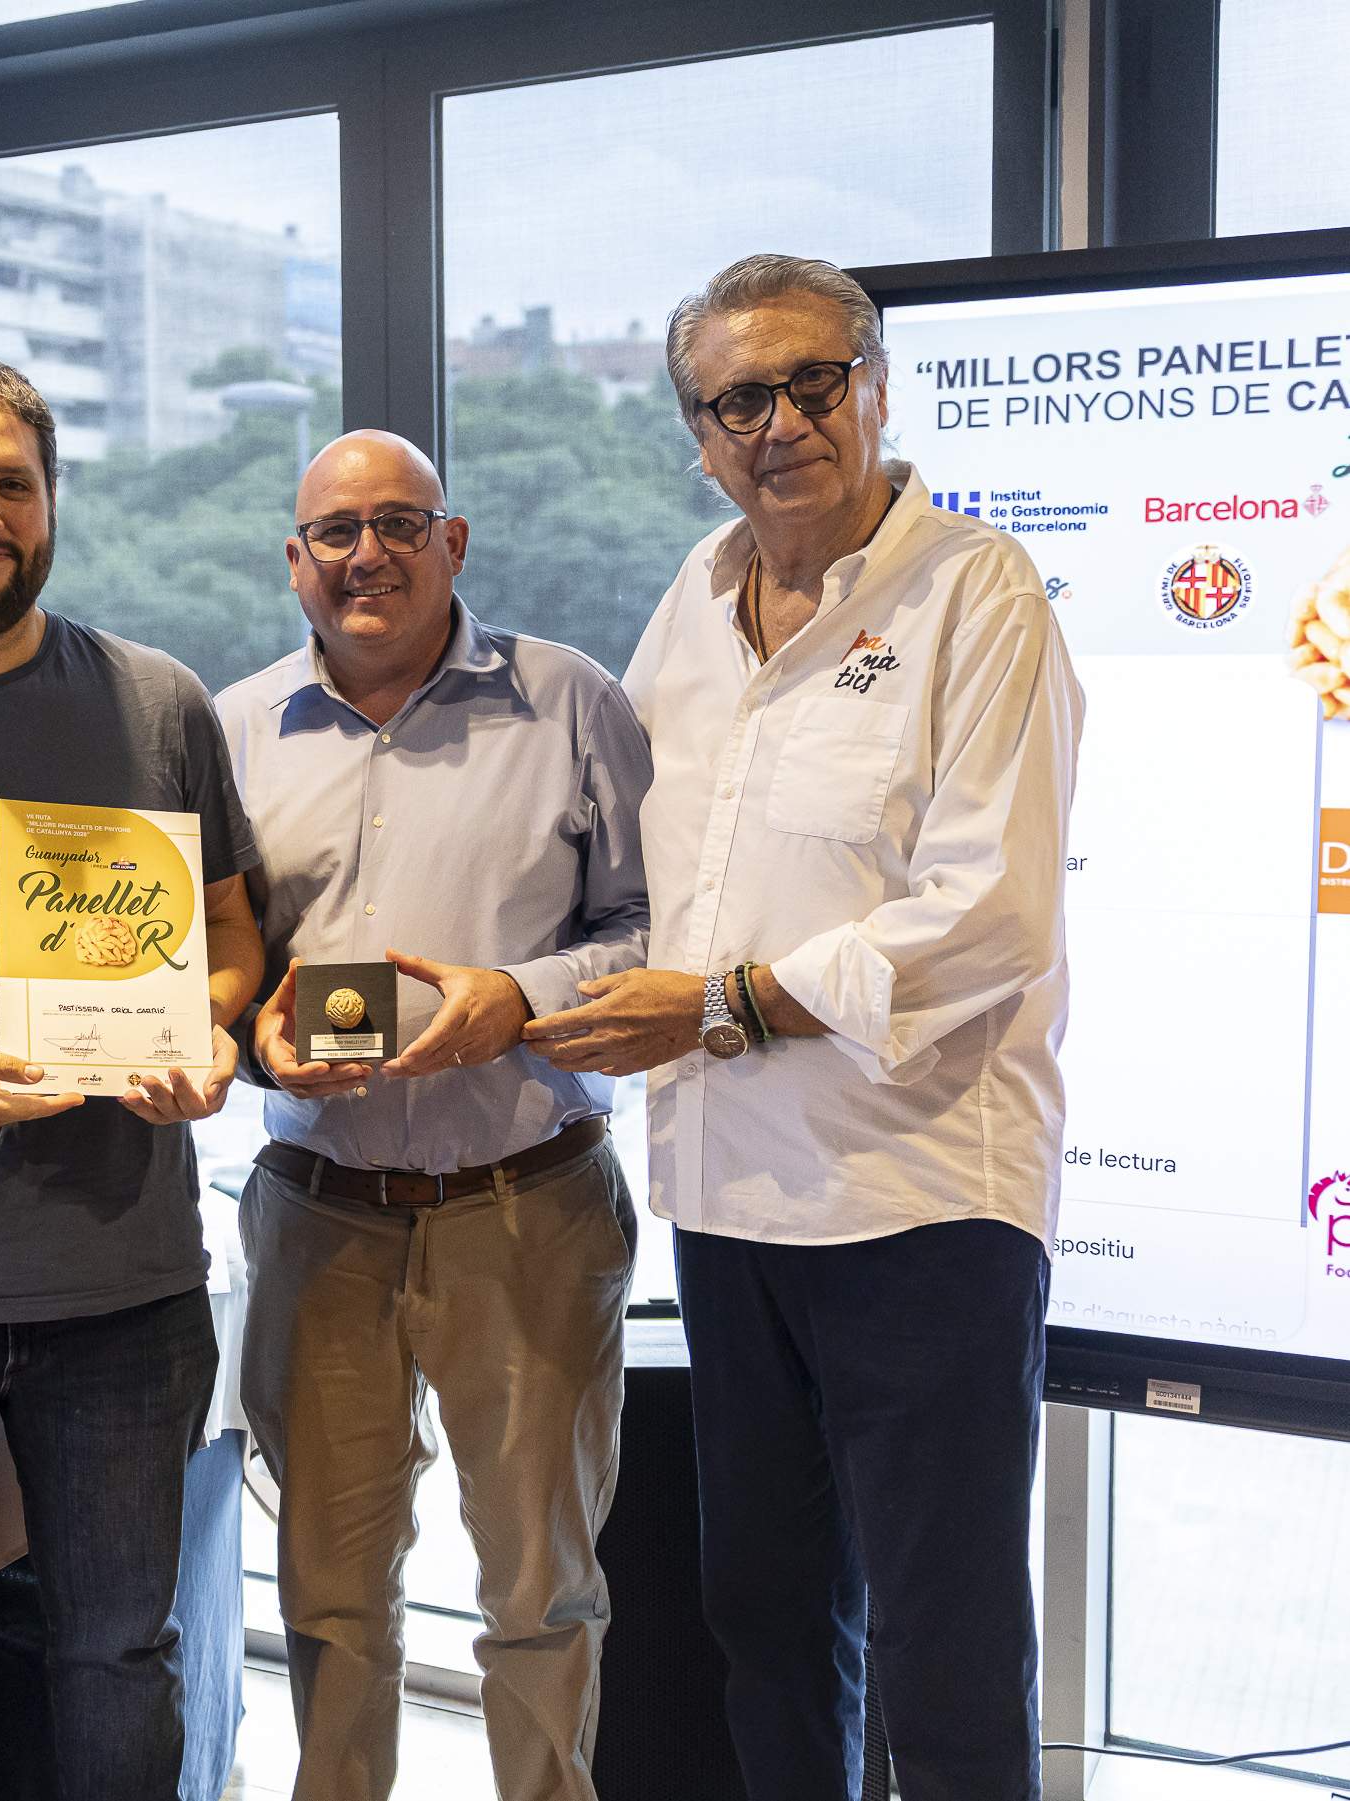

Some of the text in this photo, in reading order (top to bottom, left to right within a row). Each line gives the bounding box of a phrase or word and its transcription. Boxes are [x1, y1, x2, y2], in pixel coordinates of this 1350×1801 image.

[1137, 334, 1350, 378] PANELLE
[937, 398, 990, 430] DE
[1006, 387, 1195, 427] PINYONS
[1212, 382, 1270, 416] DE
[990, 489, 1041, 502] Institut
[990, 502, 1108, 518] de Gastronomia
[1144, 494, 1298, 523] Barcelona
[1011, 519, 1086, 533] Barcelona
[1175, 612, 1238, 629] BARCELONA
[834, 665, 877, 694] tics
[36, 828, 72, 836] CATALUNYA
[57, 823, 93, 831] PANELLETS
[25, 845, 102, 867] Guanyador
[18, 870, 170, 916] Panellet
[1064, 1146, 1176, 1173] de lectura
